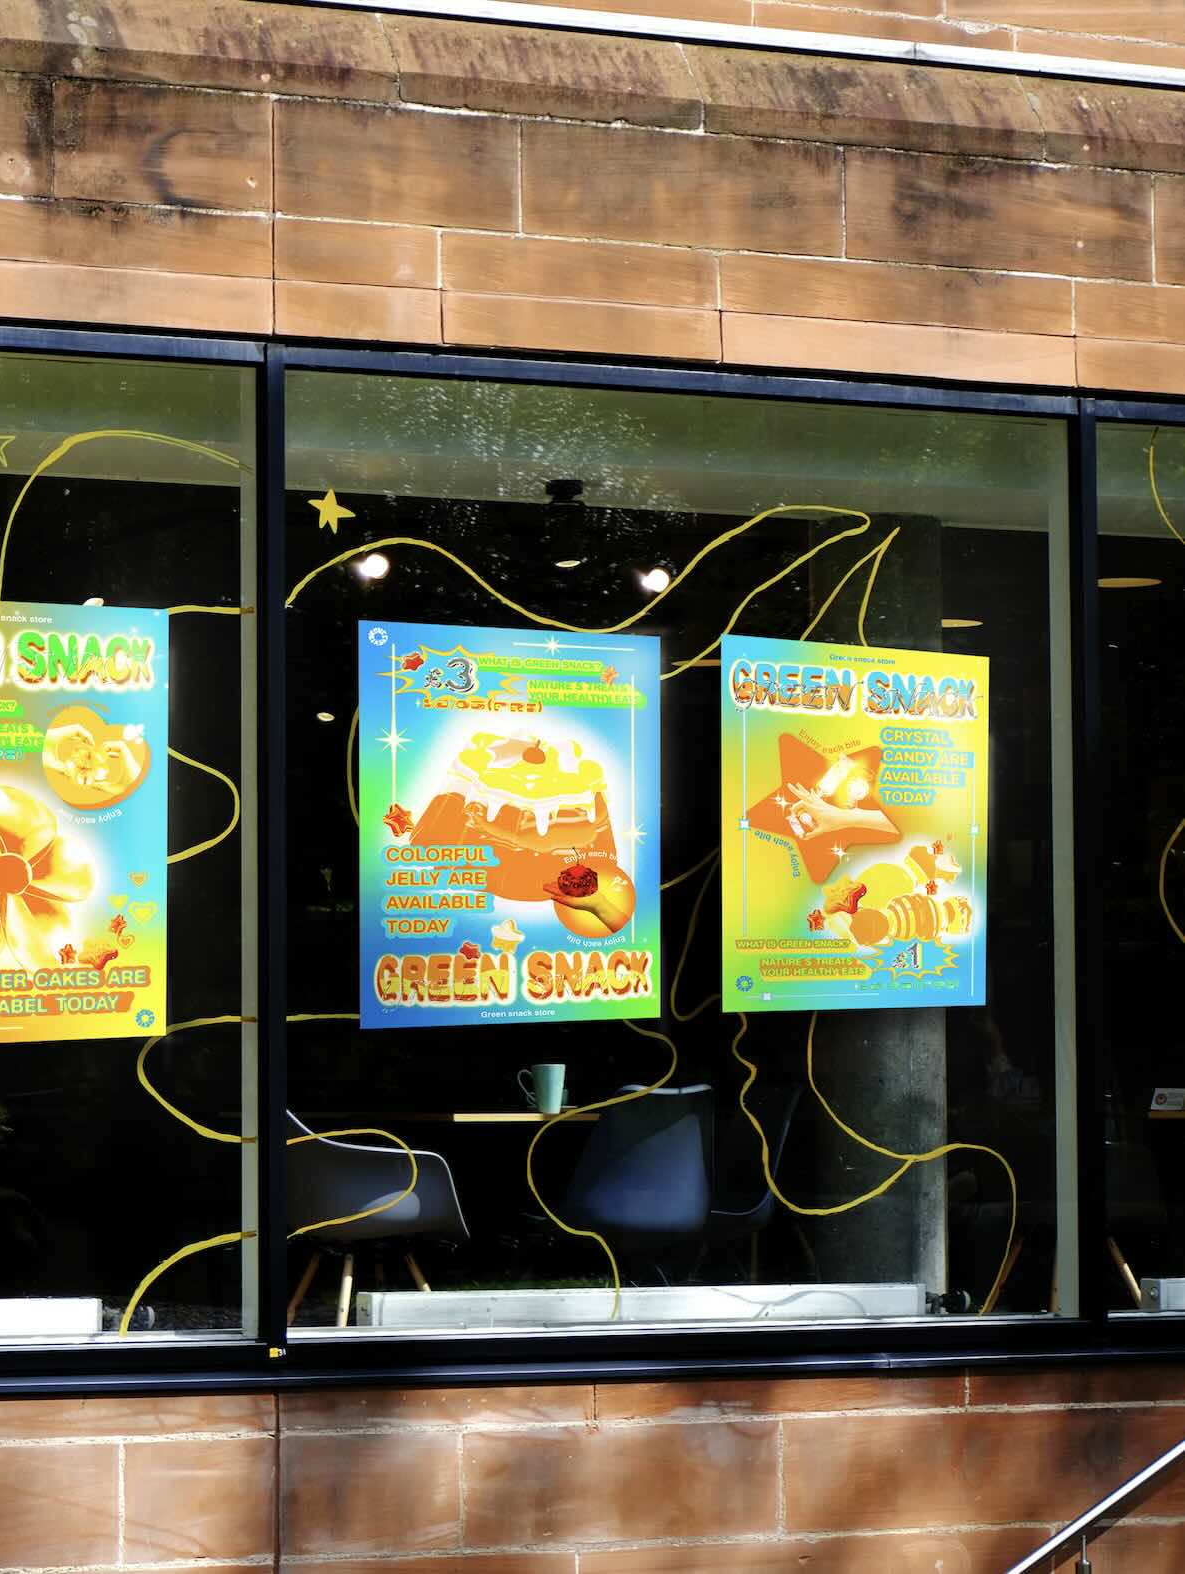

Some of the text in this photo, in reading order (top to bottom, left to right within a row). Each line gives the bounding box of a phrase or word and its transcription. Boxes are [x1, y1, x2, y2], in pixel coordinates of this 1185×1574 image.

[13, 630, 153, 688] SNACK
[479, 657, 508, 665] WHAT
[731, 660, 977, 718] GREEN SNACK
[883, 750, 934, 764] CANDY
[883, 790, 930, 803] TODAY
[386, 847, 488, 862] COLORFUL
[386, 871, 486, 886] JELLY ARE
[386, 895, 487, 910] AVAILABLE
[386, 919, 449, 934] TODAY
[736, 940, 764, 949] WHAT
[779, 940, 811, 949] GREEN
[34, 970, 100, 988] CAKES
[108, 968, 146, 985] ARE
[376, 951, 651, 1004] GREEN SNACK
[56, 996, 119, 1013] TODAY
